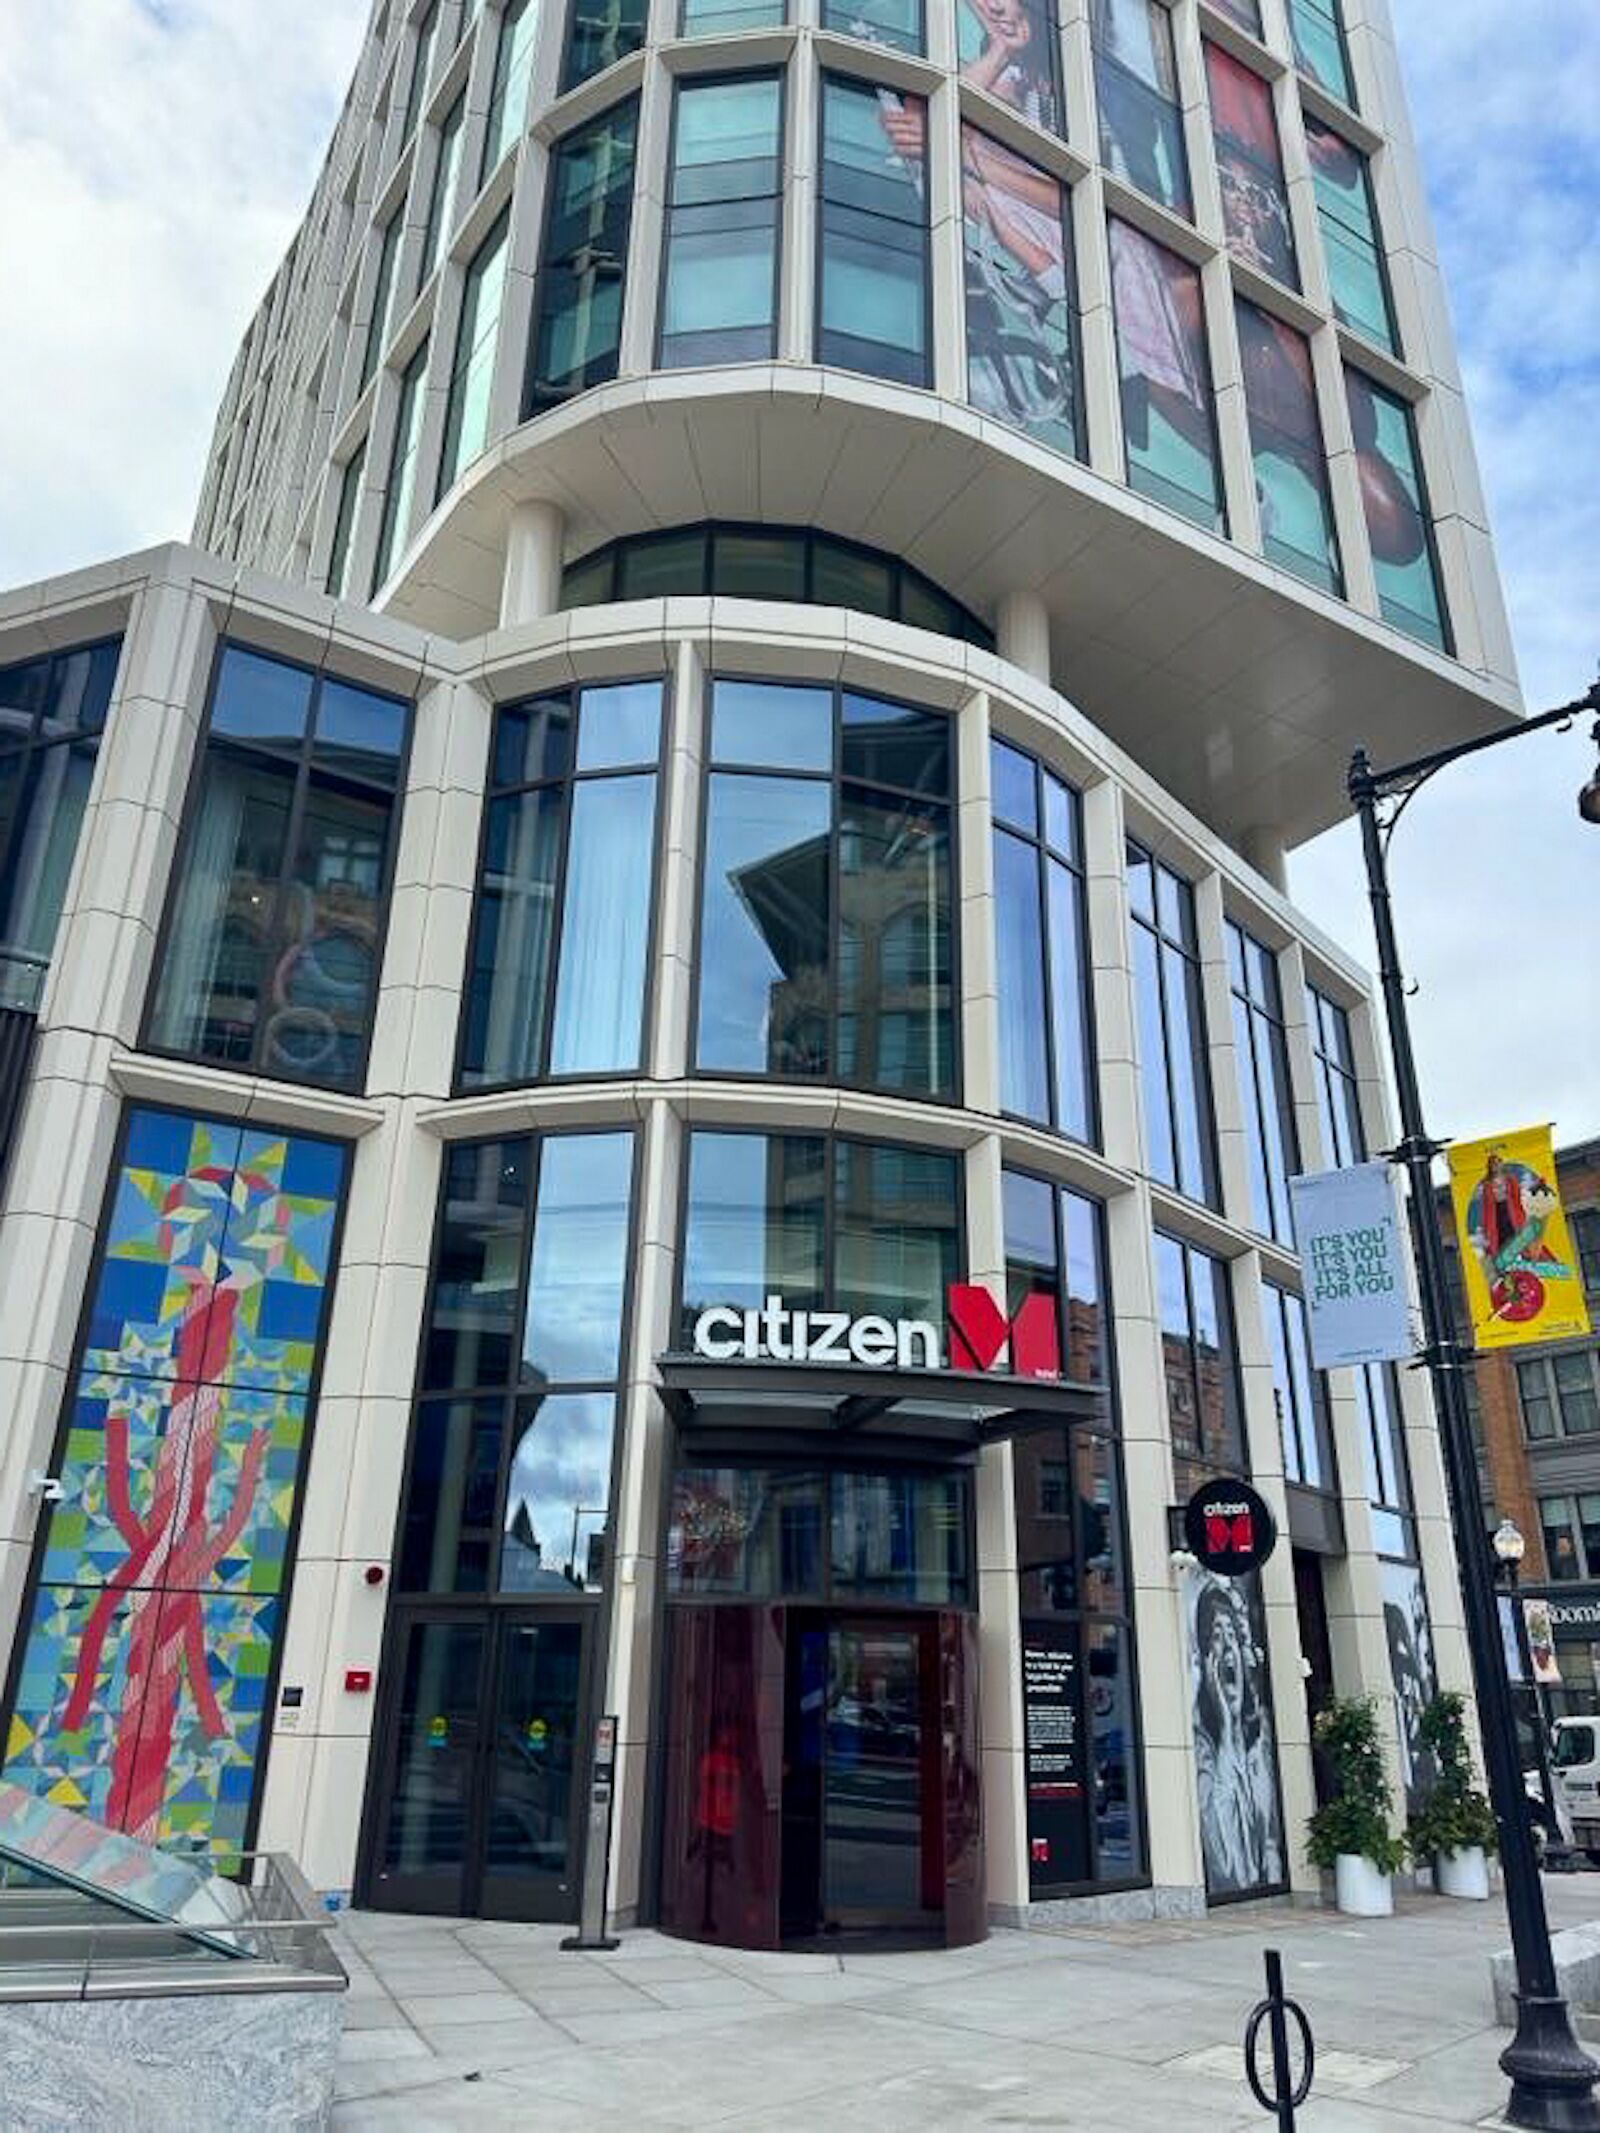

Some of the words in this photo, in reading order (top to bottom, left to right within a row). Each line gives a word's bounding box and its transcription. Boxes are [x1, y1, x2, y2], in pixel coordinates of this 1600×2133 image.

[1311, 1234, 1344, 1253] IT'S
[1345, 1227, 1384, 1246] YOU
[1347, 1245, 1386, 1263] YOU
[1355, 1260, 1389, 1278] ALL
[1315, 1283, 1352, 1302] FOR
[1354, 1276, 1393, 1296] YOU
